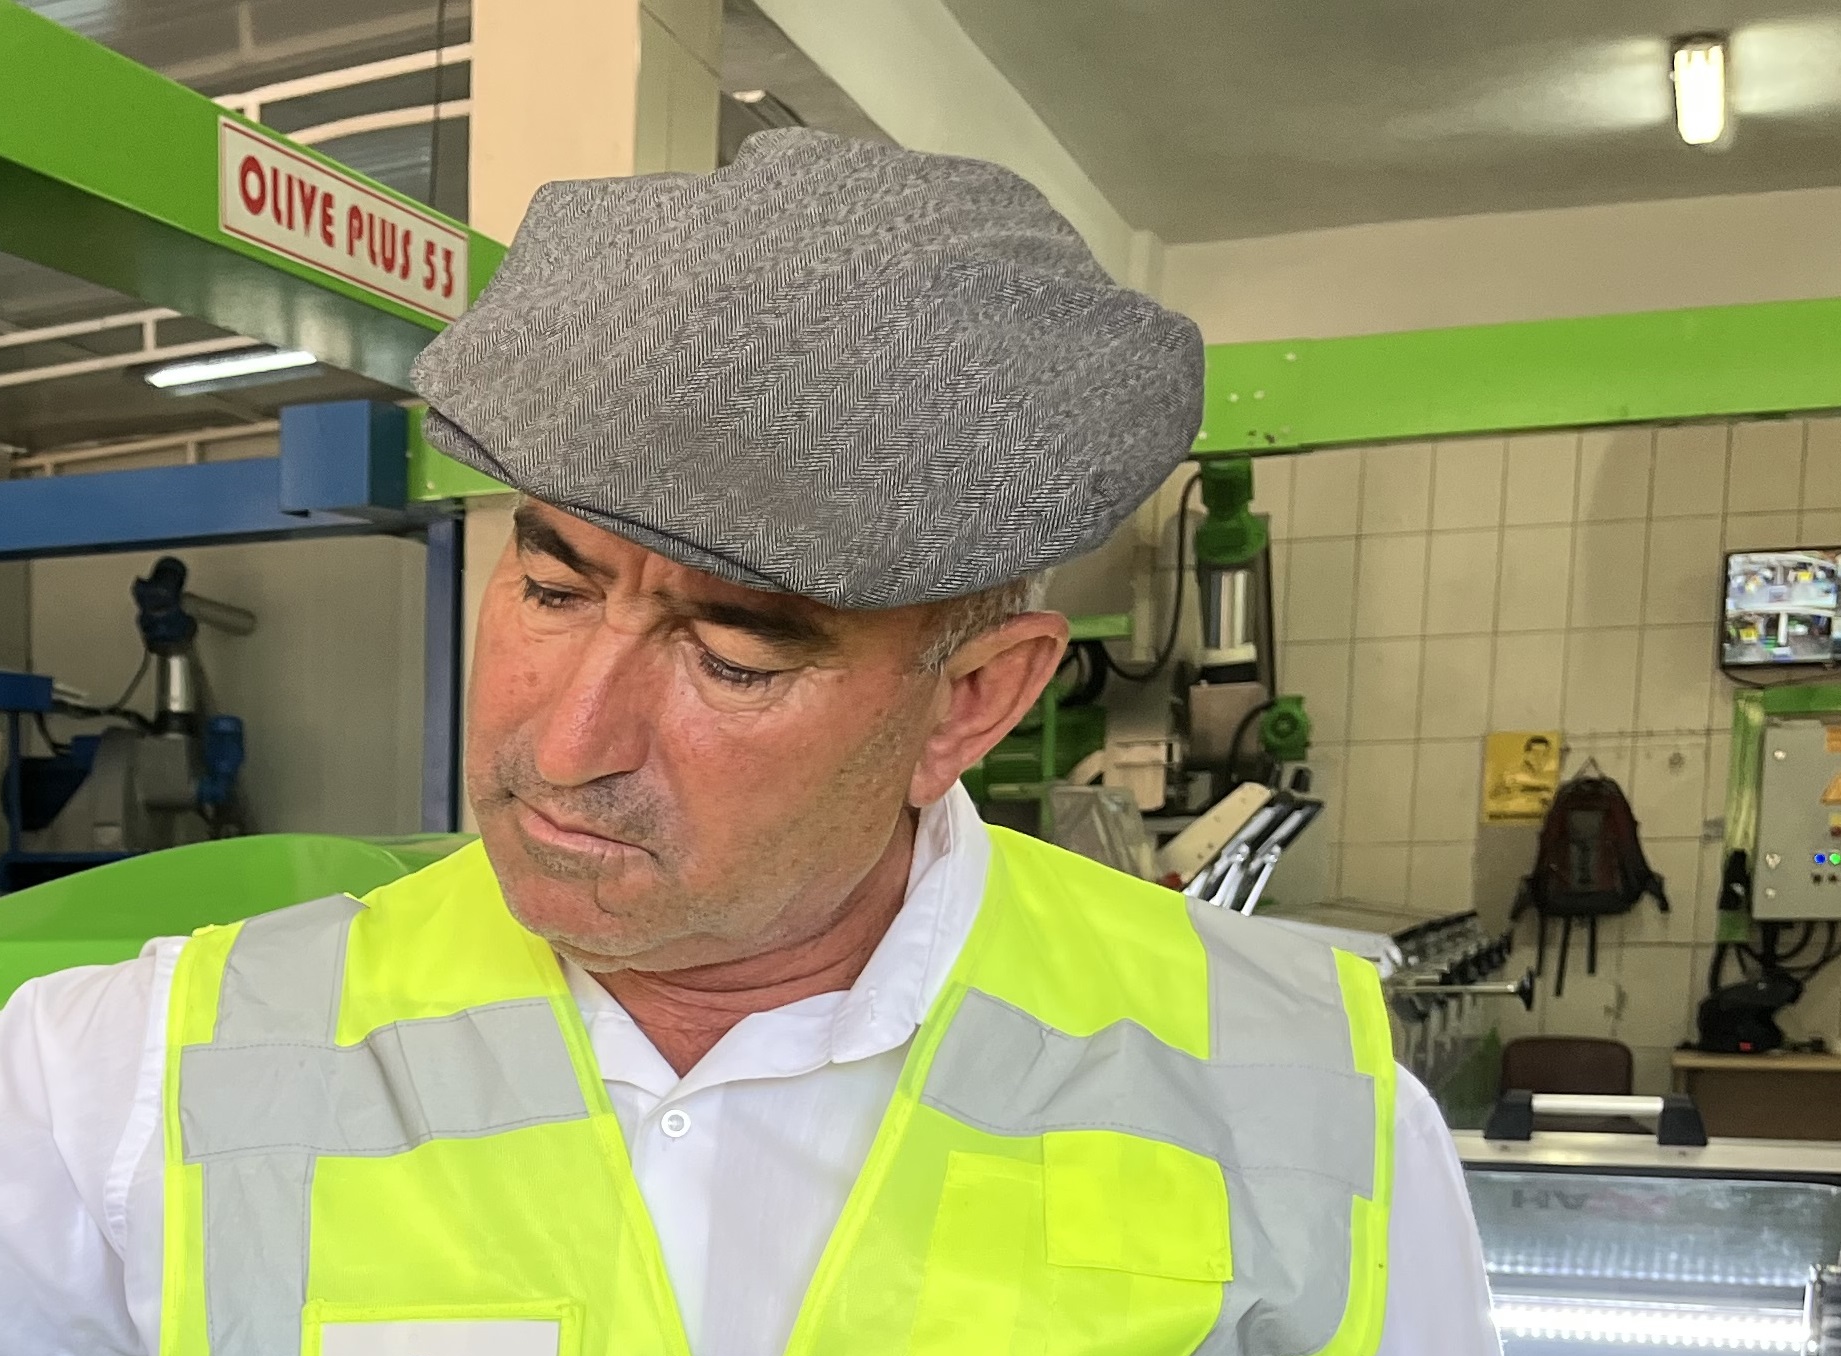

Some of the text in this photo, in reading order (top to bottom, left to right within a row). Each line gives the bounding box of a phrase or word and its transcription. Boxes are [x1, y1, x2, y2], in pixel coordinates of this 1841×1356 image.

[238, 155, 455, 299] OLIVE PLUS 53
